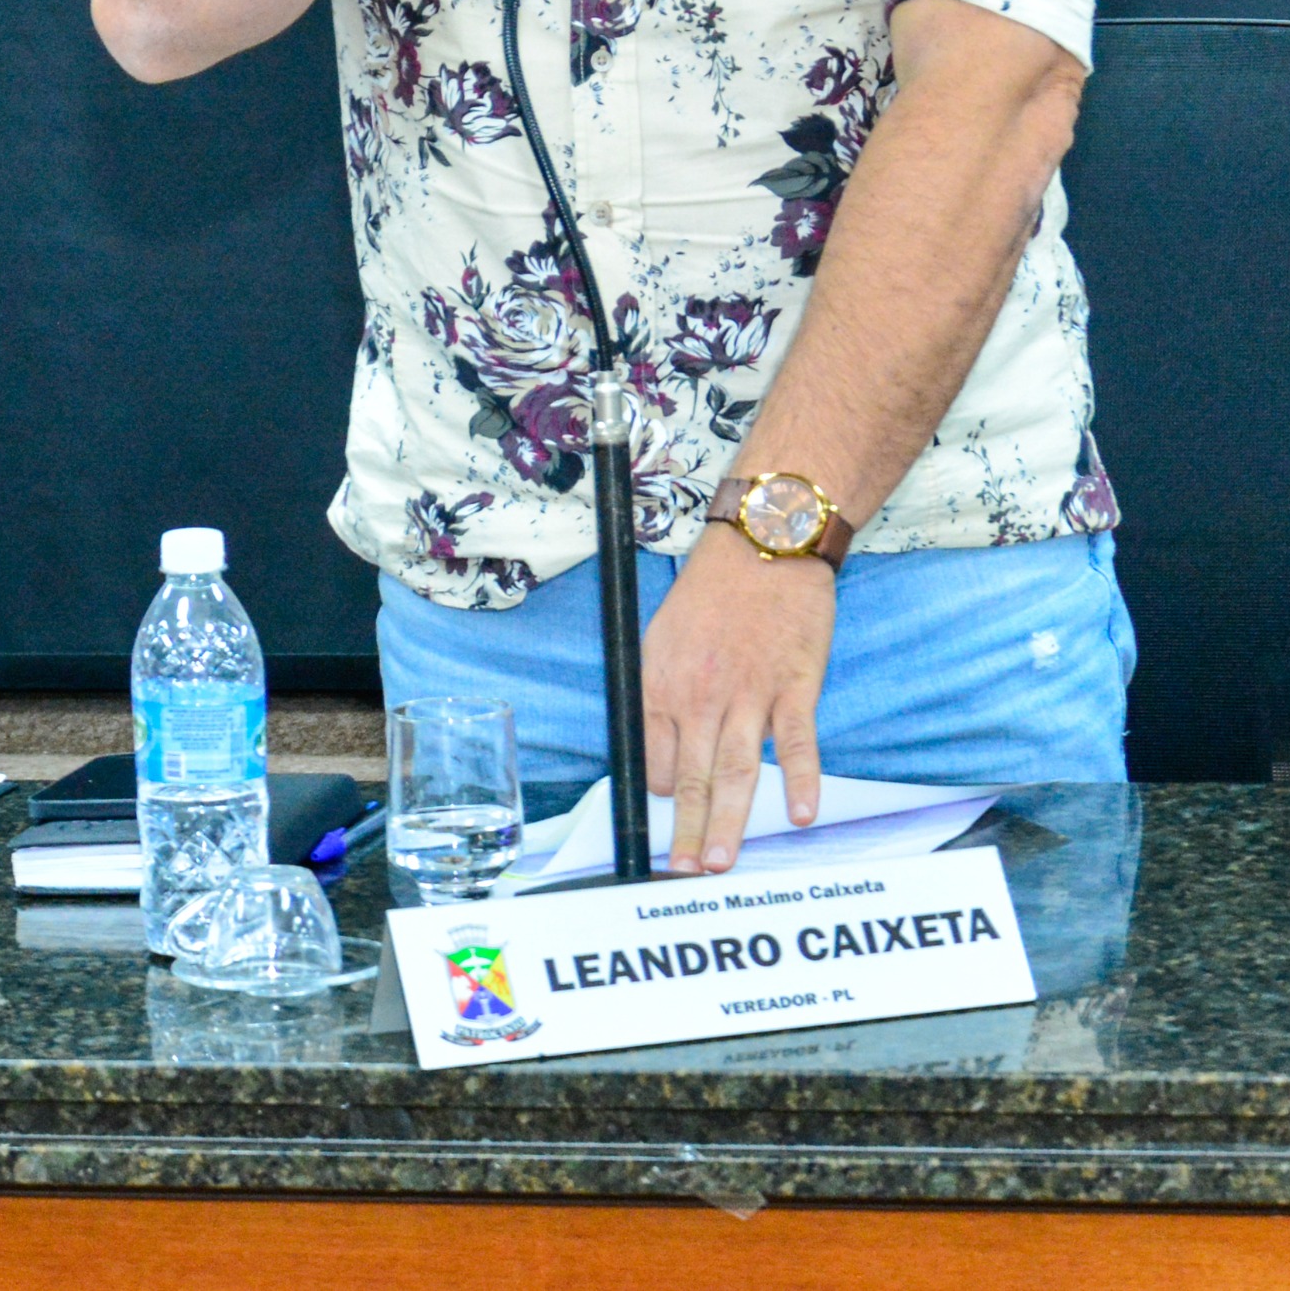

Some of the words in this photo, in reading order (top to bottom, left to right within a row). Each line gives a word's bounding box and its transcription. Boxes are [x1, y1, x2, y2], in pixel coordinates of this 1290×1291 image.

[636, 899, 719, 920] Leandro
[724, 890, 804, 910] Maximo
[809, 879, 886, 901] Caixeta
[544, 932, 781, 992] LEANDRO
[796, 908, 1001, 961] CAIXETA
[720, 992, 818, 1015] VEREADOR
[831, 988, 856, 1002] PL
